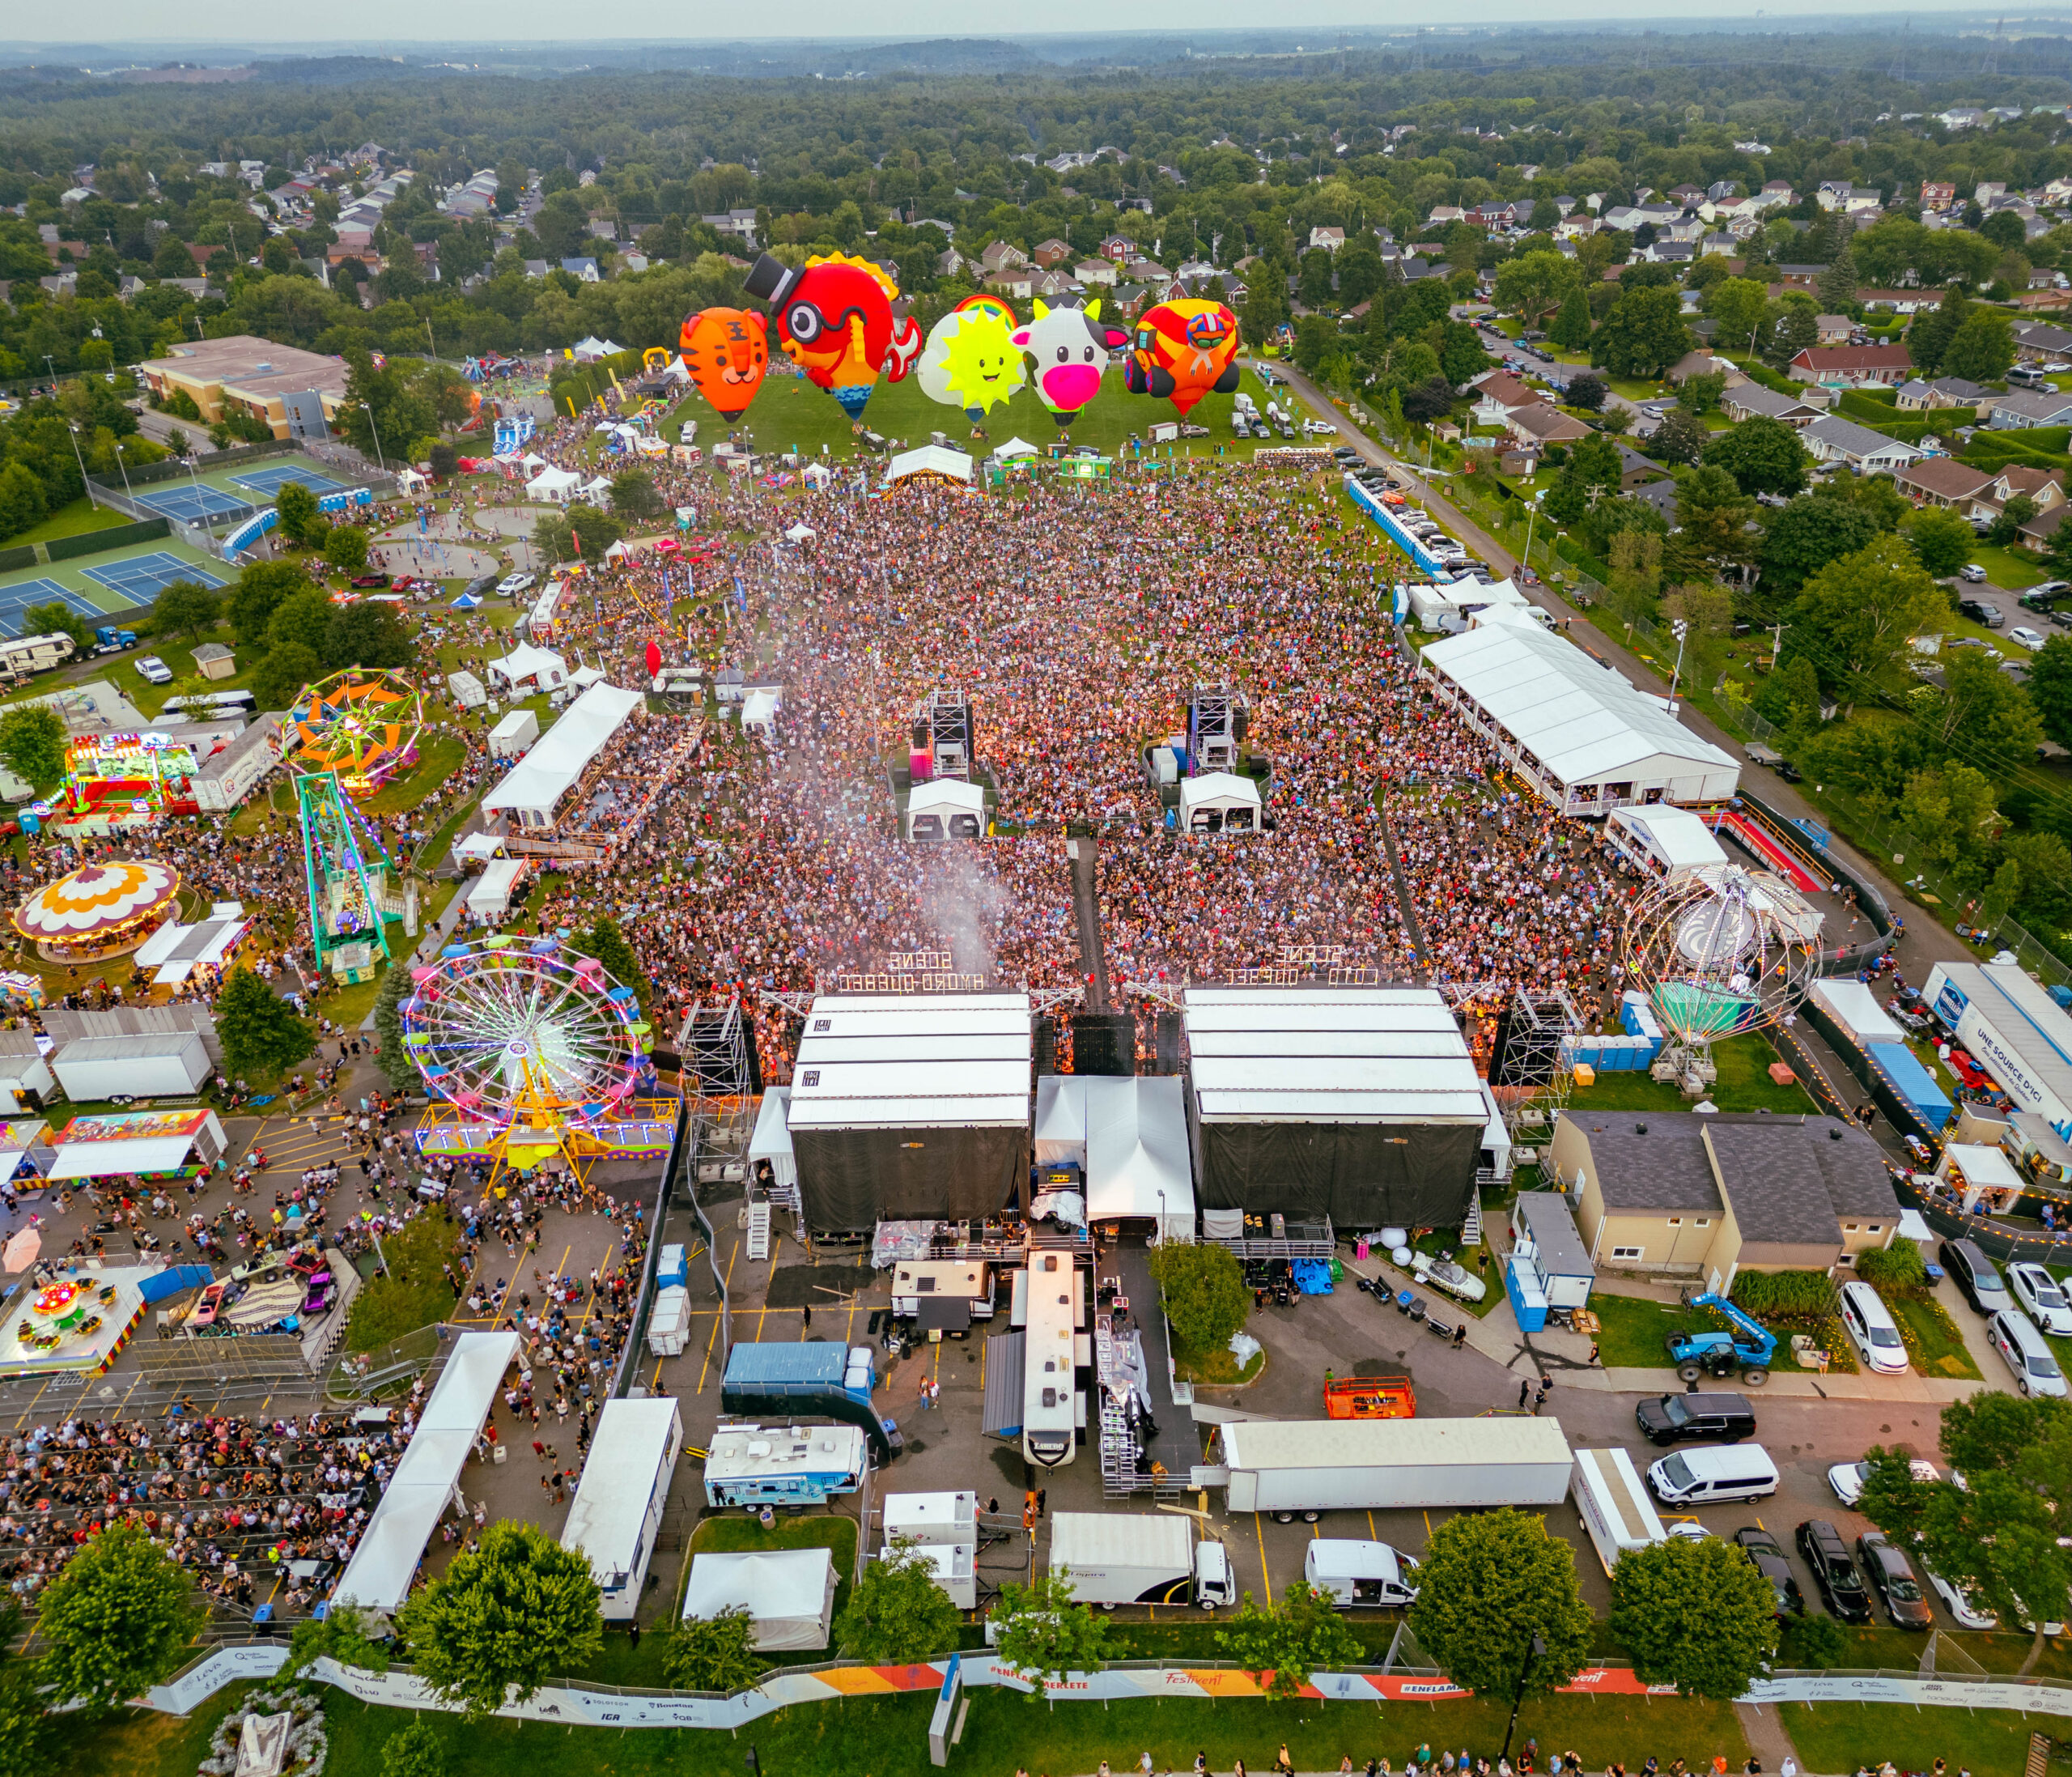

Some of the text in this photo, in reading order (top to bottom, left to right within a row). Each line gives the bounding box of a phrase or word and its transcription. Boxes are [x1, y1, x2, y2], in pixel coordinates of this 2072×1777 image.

[1631, 822, 1651, 843] BUD LIGHT
[1977, 1028, 1993, 1048] UNE
[1993, 1046, 2023, 1082] SOURCE
[2008, 1078, 2015, 1086] du
[1034, 1443, 1064, 1451] LAREDO
[1166, 1672, 1227, 1686] Festivent
[601, 1713, 621, 1722] IGA
[673, 1713, 693, 1722] YQB
